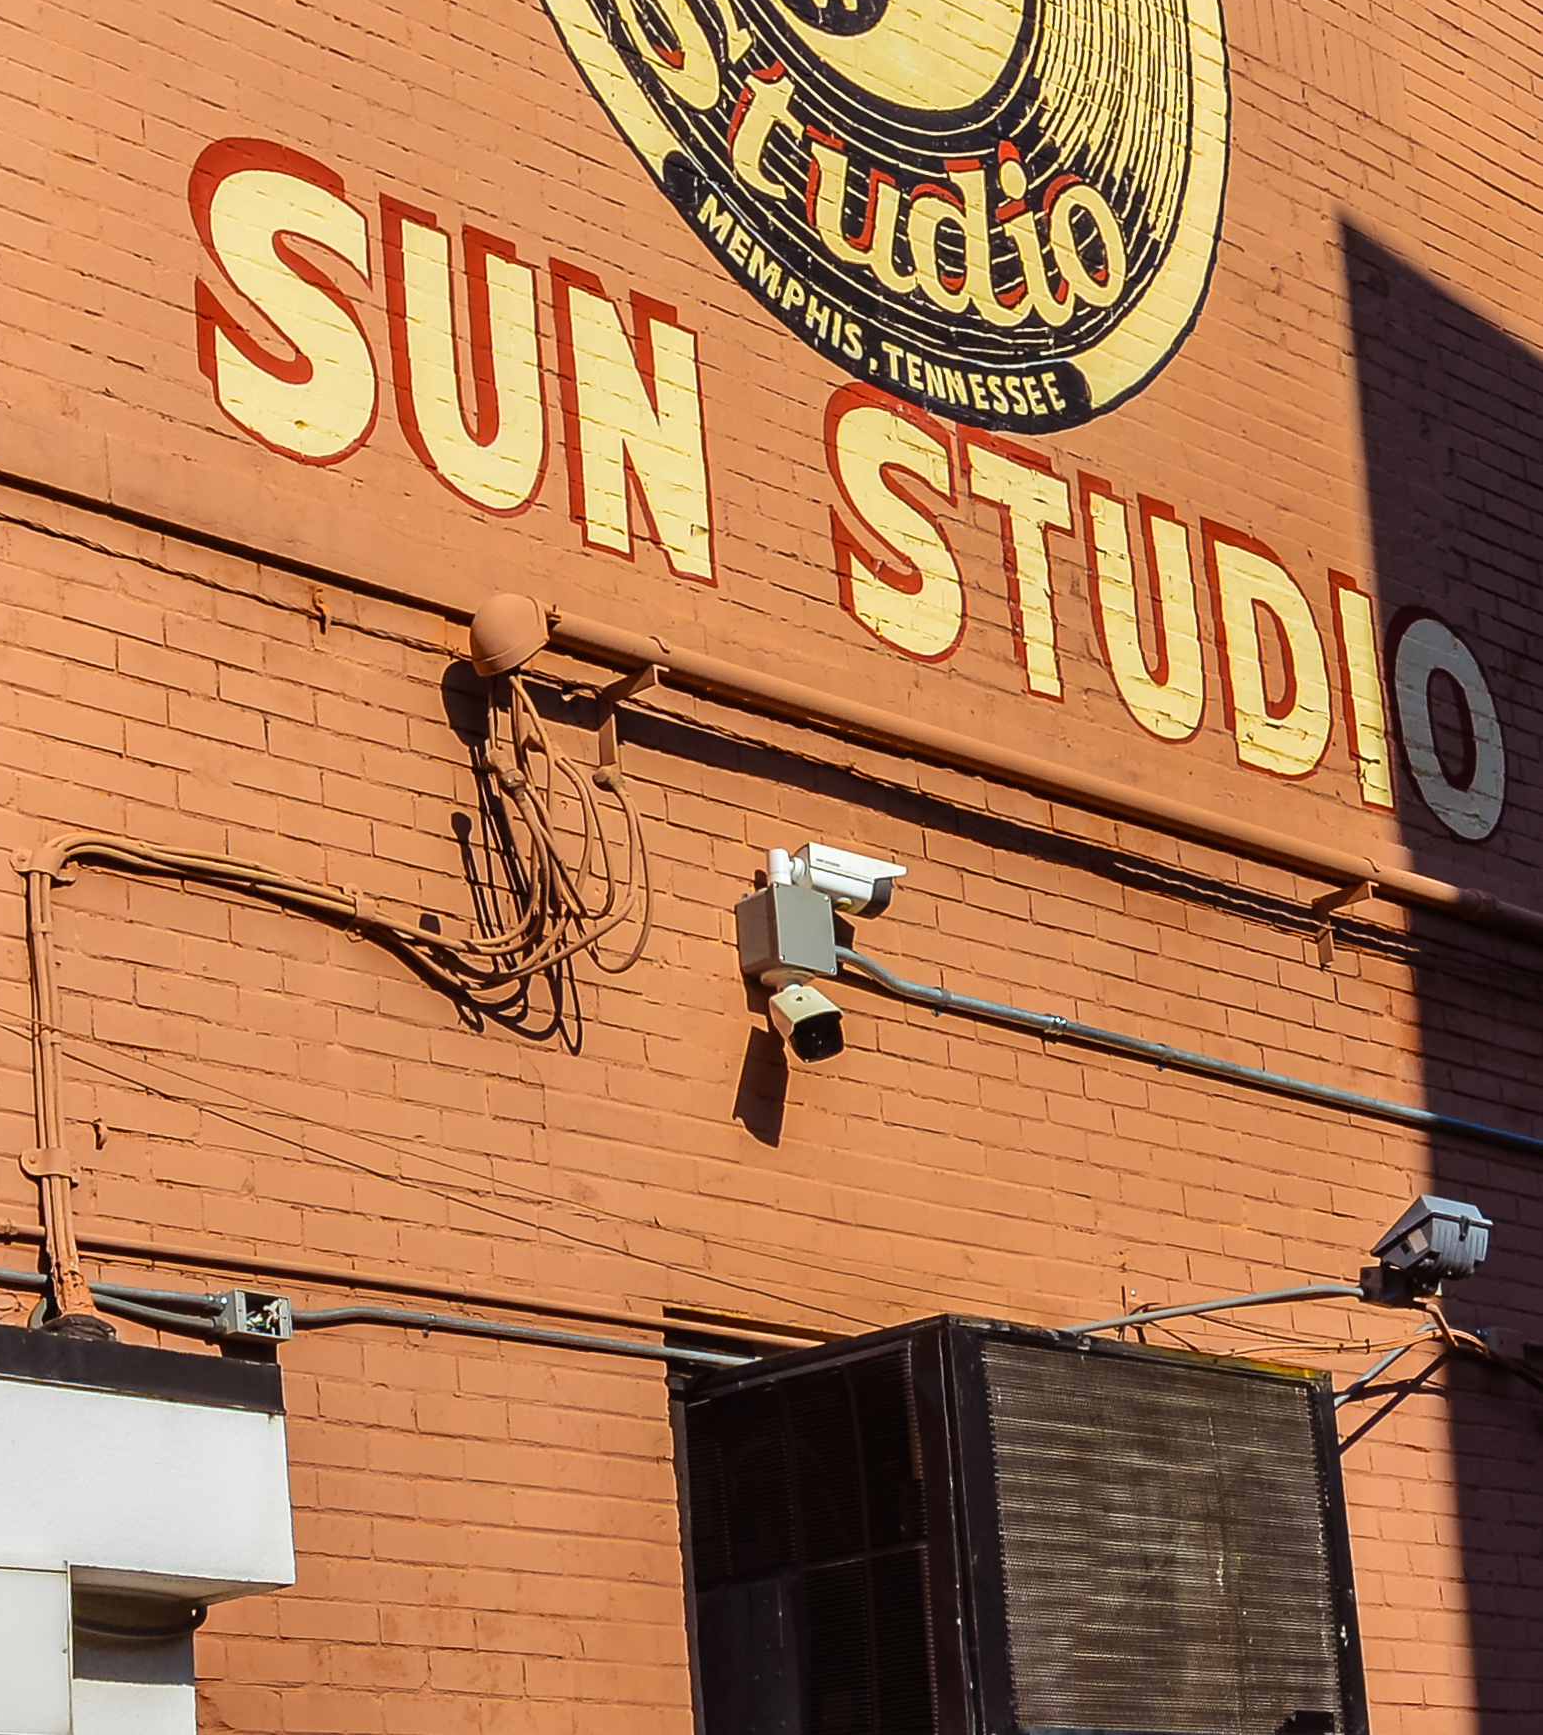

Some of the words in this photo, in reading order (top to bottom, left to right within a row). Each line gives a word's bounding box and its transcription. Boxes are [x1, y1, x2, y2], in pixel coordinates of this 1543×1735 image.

[188, 136, 718, 587] SUN
[824, 381, 1507, 843] STUDIO
[880, 339, 1067, 417] TENNESSEE
